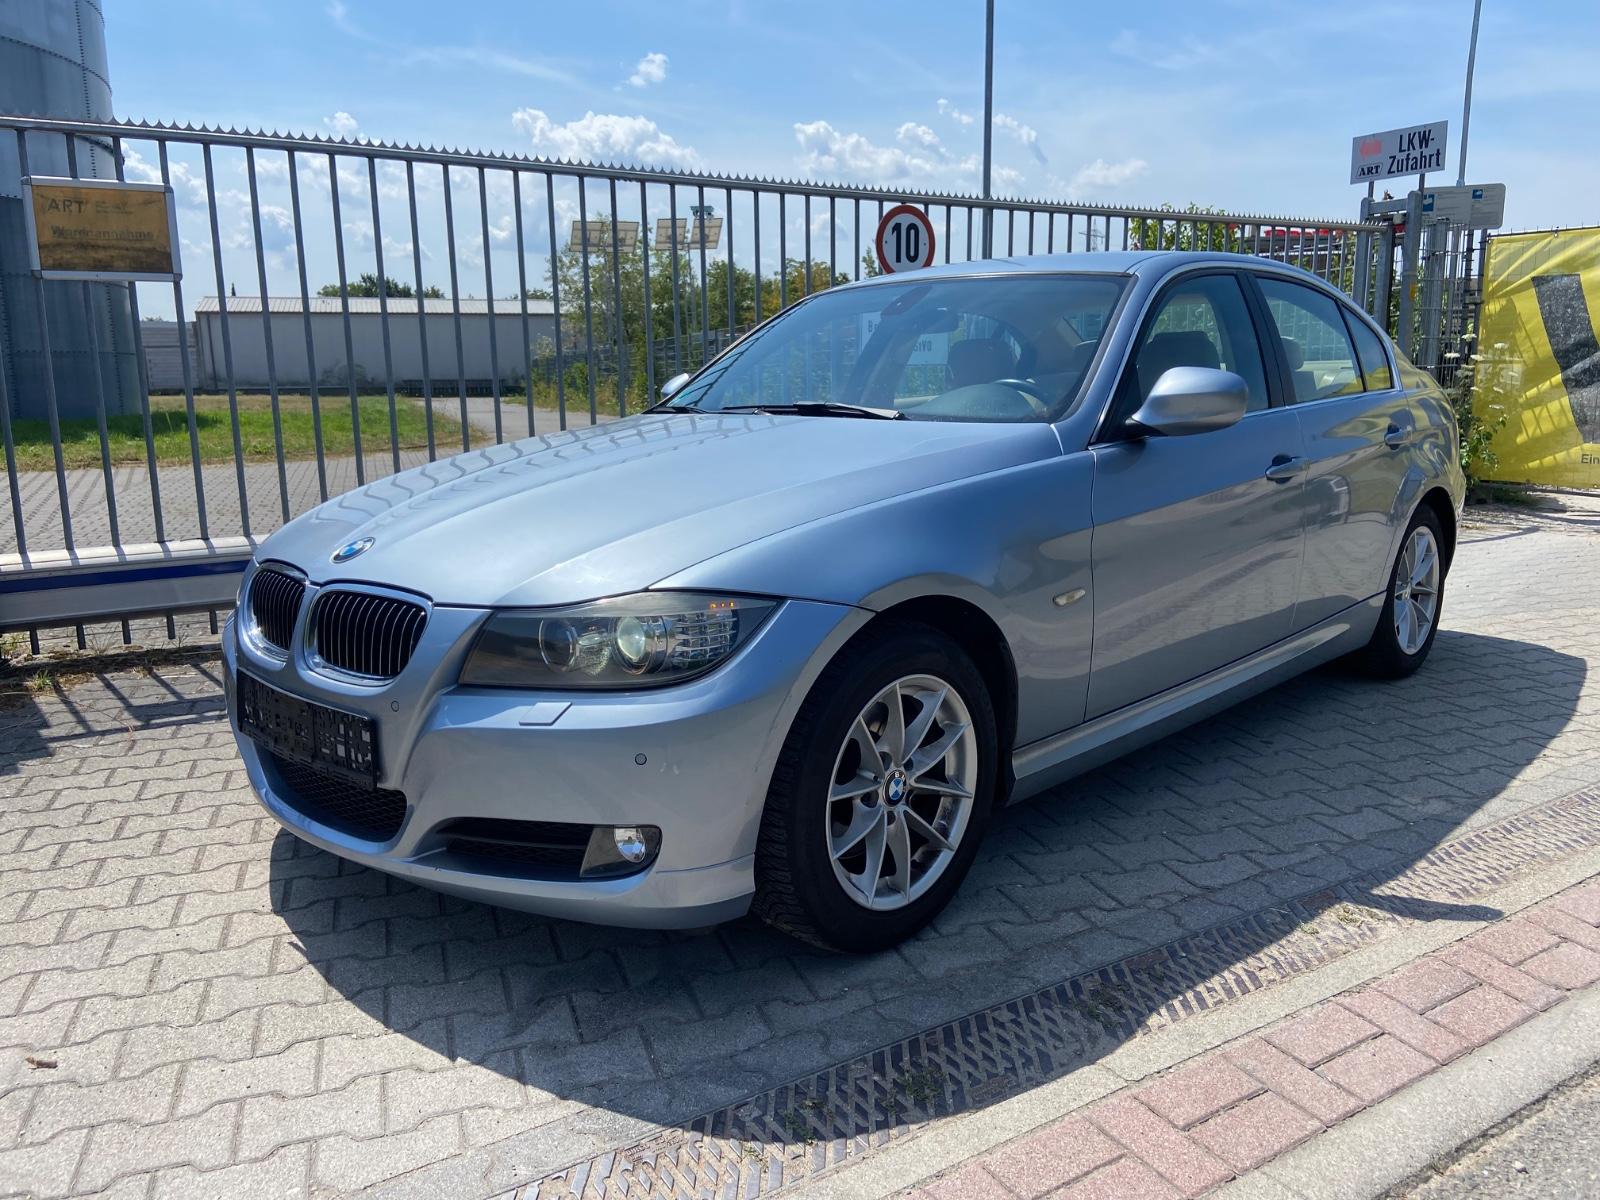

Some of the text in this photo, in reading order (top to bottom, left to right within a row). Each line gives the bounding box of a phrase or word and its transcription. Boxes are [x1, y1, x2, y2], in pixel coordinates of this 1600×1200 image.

[1398, 129, 1435, 153] LKW-
[1358, 164, 1381, 177] ART
[1387, 149, 1441, 175] Zufahrt
[47, 198, 84, 214] ART
[891, 222, 920, 264] 10
